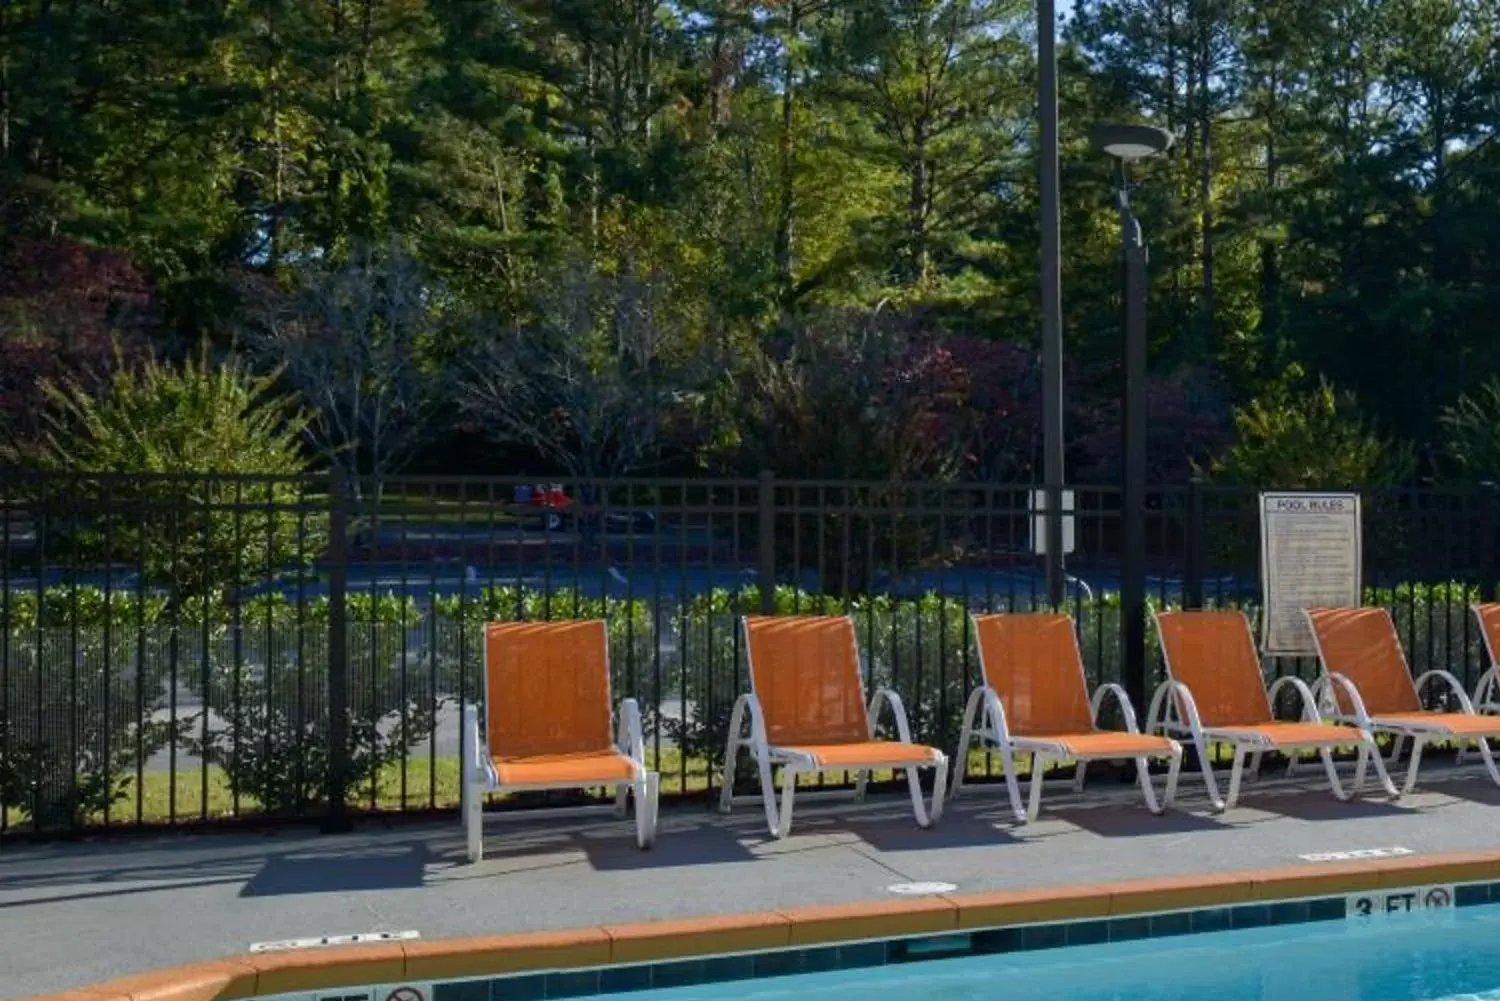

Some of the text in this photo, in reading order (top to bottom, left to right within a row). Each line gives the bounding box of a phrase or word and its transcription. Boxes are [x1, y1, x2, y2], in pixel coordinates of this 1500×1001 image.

[1277, 499, 1345, 511] POOL RULES
[1386, 893, 1417, 913] FT
